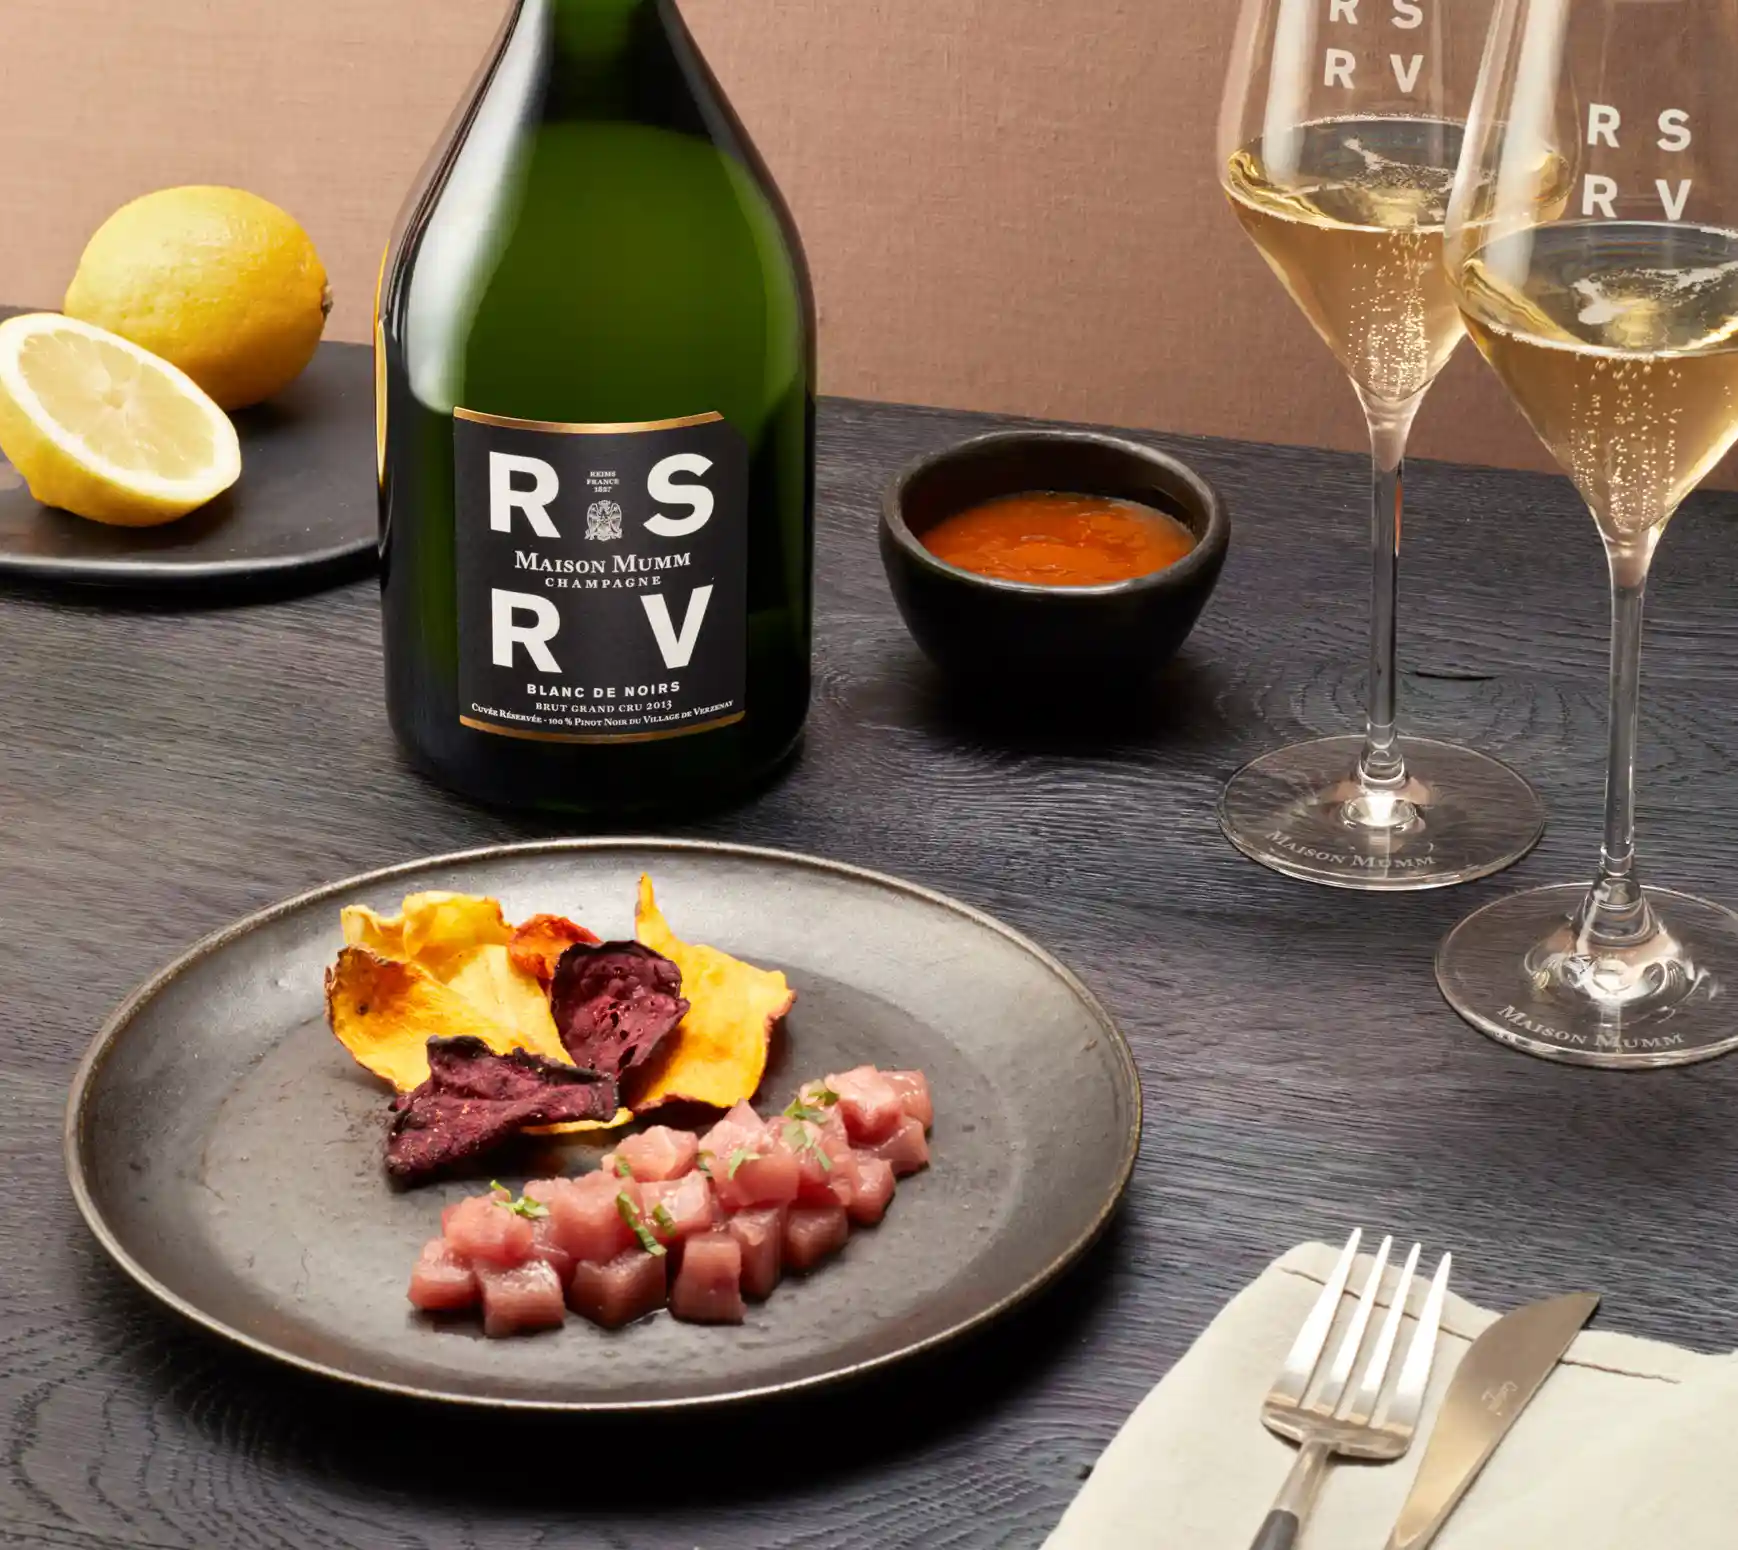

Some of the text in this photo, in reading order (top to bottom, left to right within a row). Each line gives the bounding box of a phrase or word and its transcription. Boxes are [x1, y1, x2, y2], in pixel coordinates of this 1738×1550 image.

[1324, 48, 1424, 93] R V
[1587, 103, 1692, 152] R S
[1582, 173, 1692, 221] R V
[489, 451, 714, 538] R S
[514, 550, 691, 574] MAISON MUMM
[545, 576, 662, 588] CHAMPAGNE
[491, 585, 714, 673] R V
[527, 681, 680, 698] BLANC DE NOIRS
[535, 700, 672, 713] BRUT GRAND CRU 2013
[548, 717, 563, 725] 100
[565, 717, 573, 726] %
[629, 717, 641, 725] DU
[681, 710, 693, 719] DE
